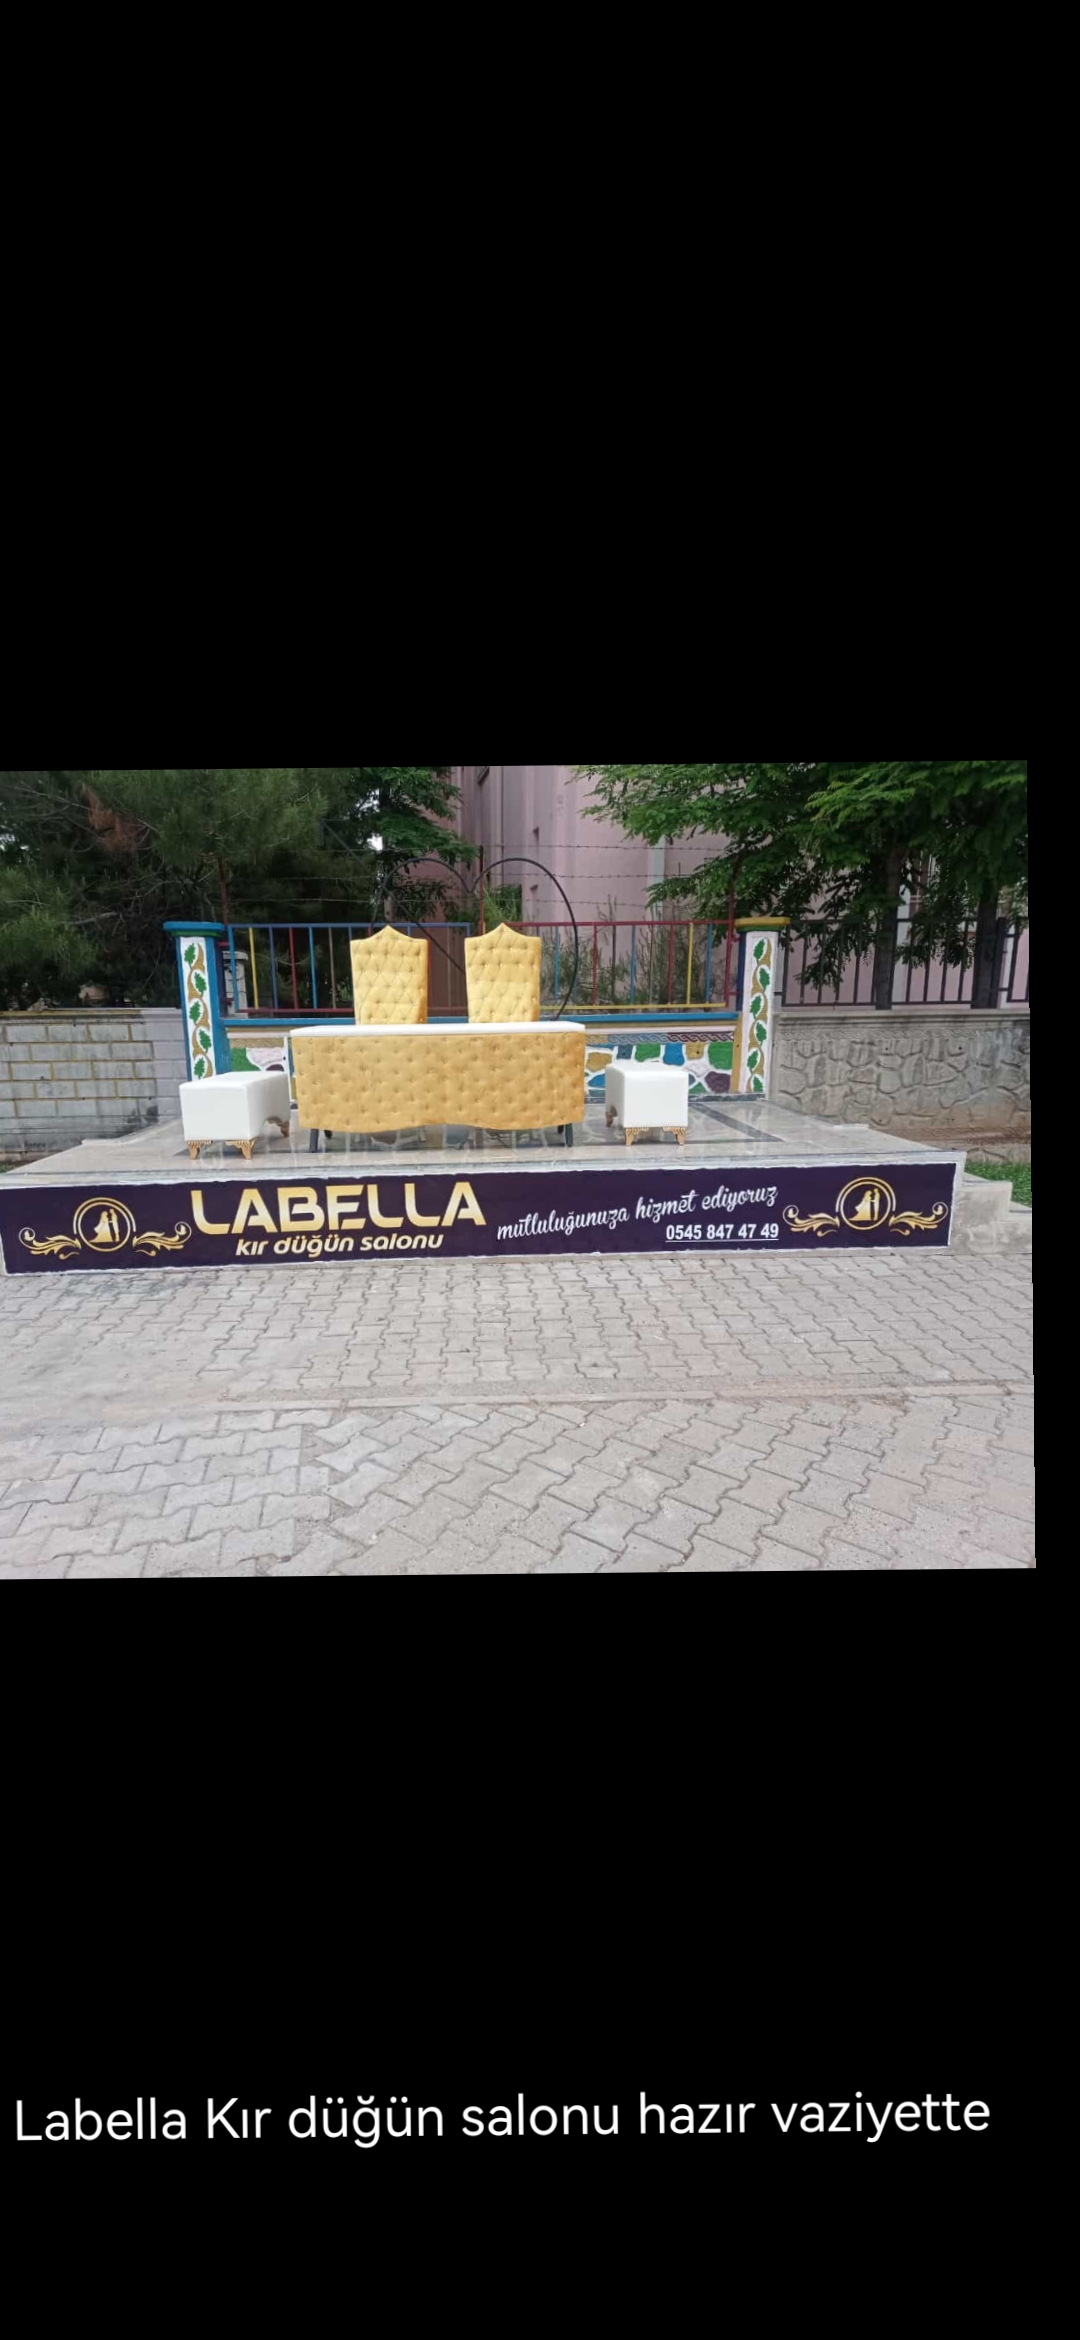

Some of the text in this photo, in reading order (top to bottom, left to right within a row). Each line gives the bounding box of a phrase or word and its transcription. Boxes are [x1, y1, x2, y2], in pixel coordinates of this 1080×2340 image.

[190, 1181, 487, 1235] LABELLA
[496, 1184, 779, 1240] mutluluğunuza hizmet ediyoruz
[235, 1232, 445, 1258] kır düğün salonu
[666, 1223, 779, 1240] 0545 847 47 49
